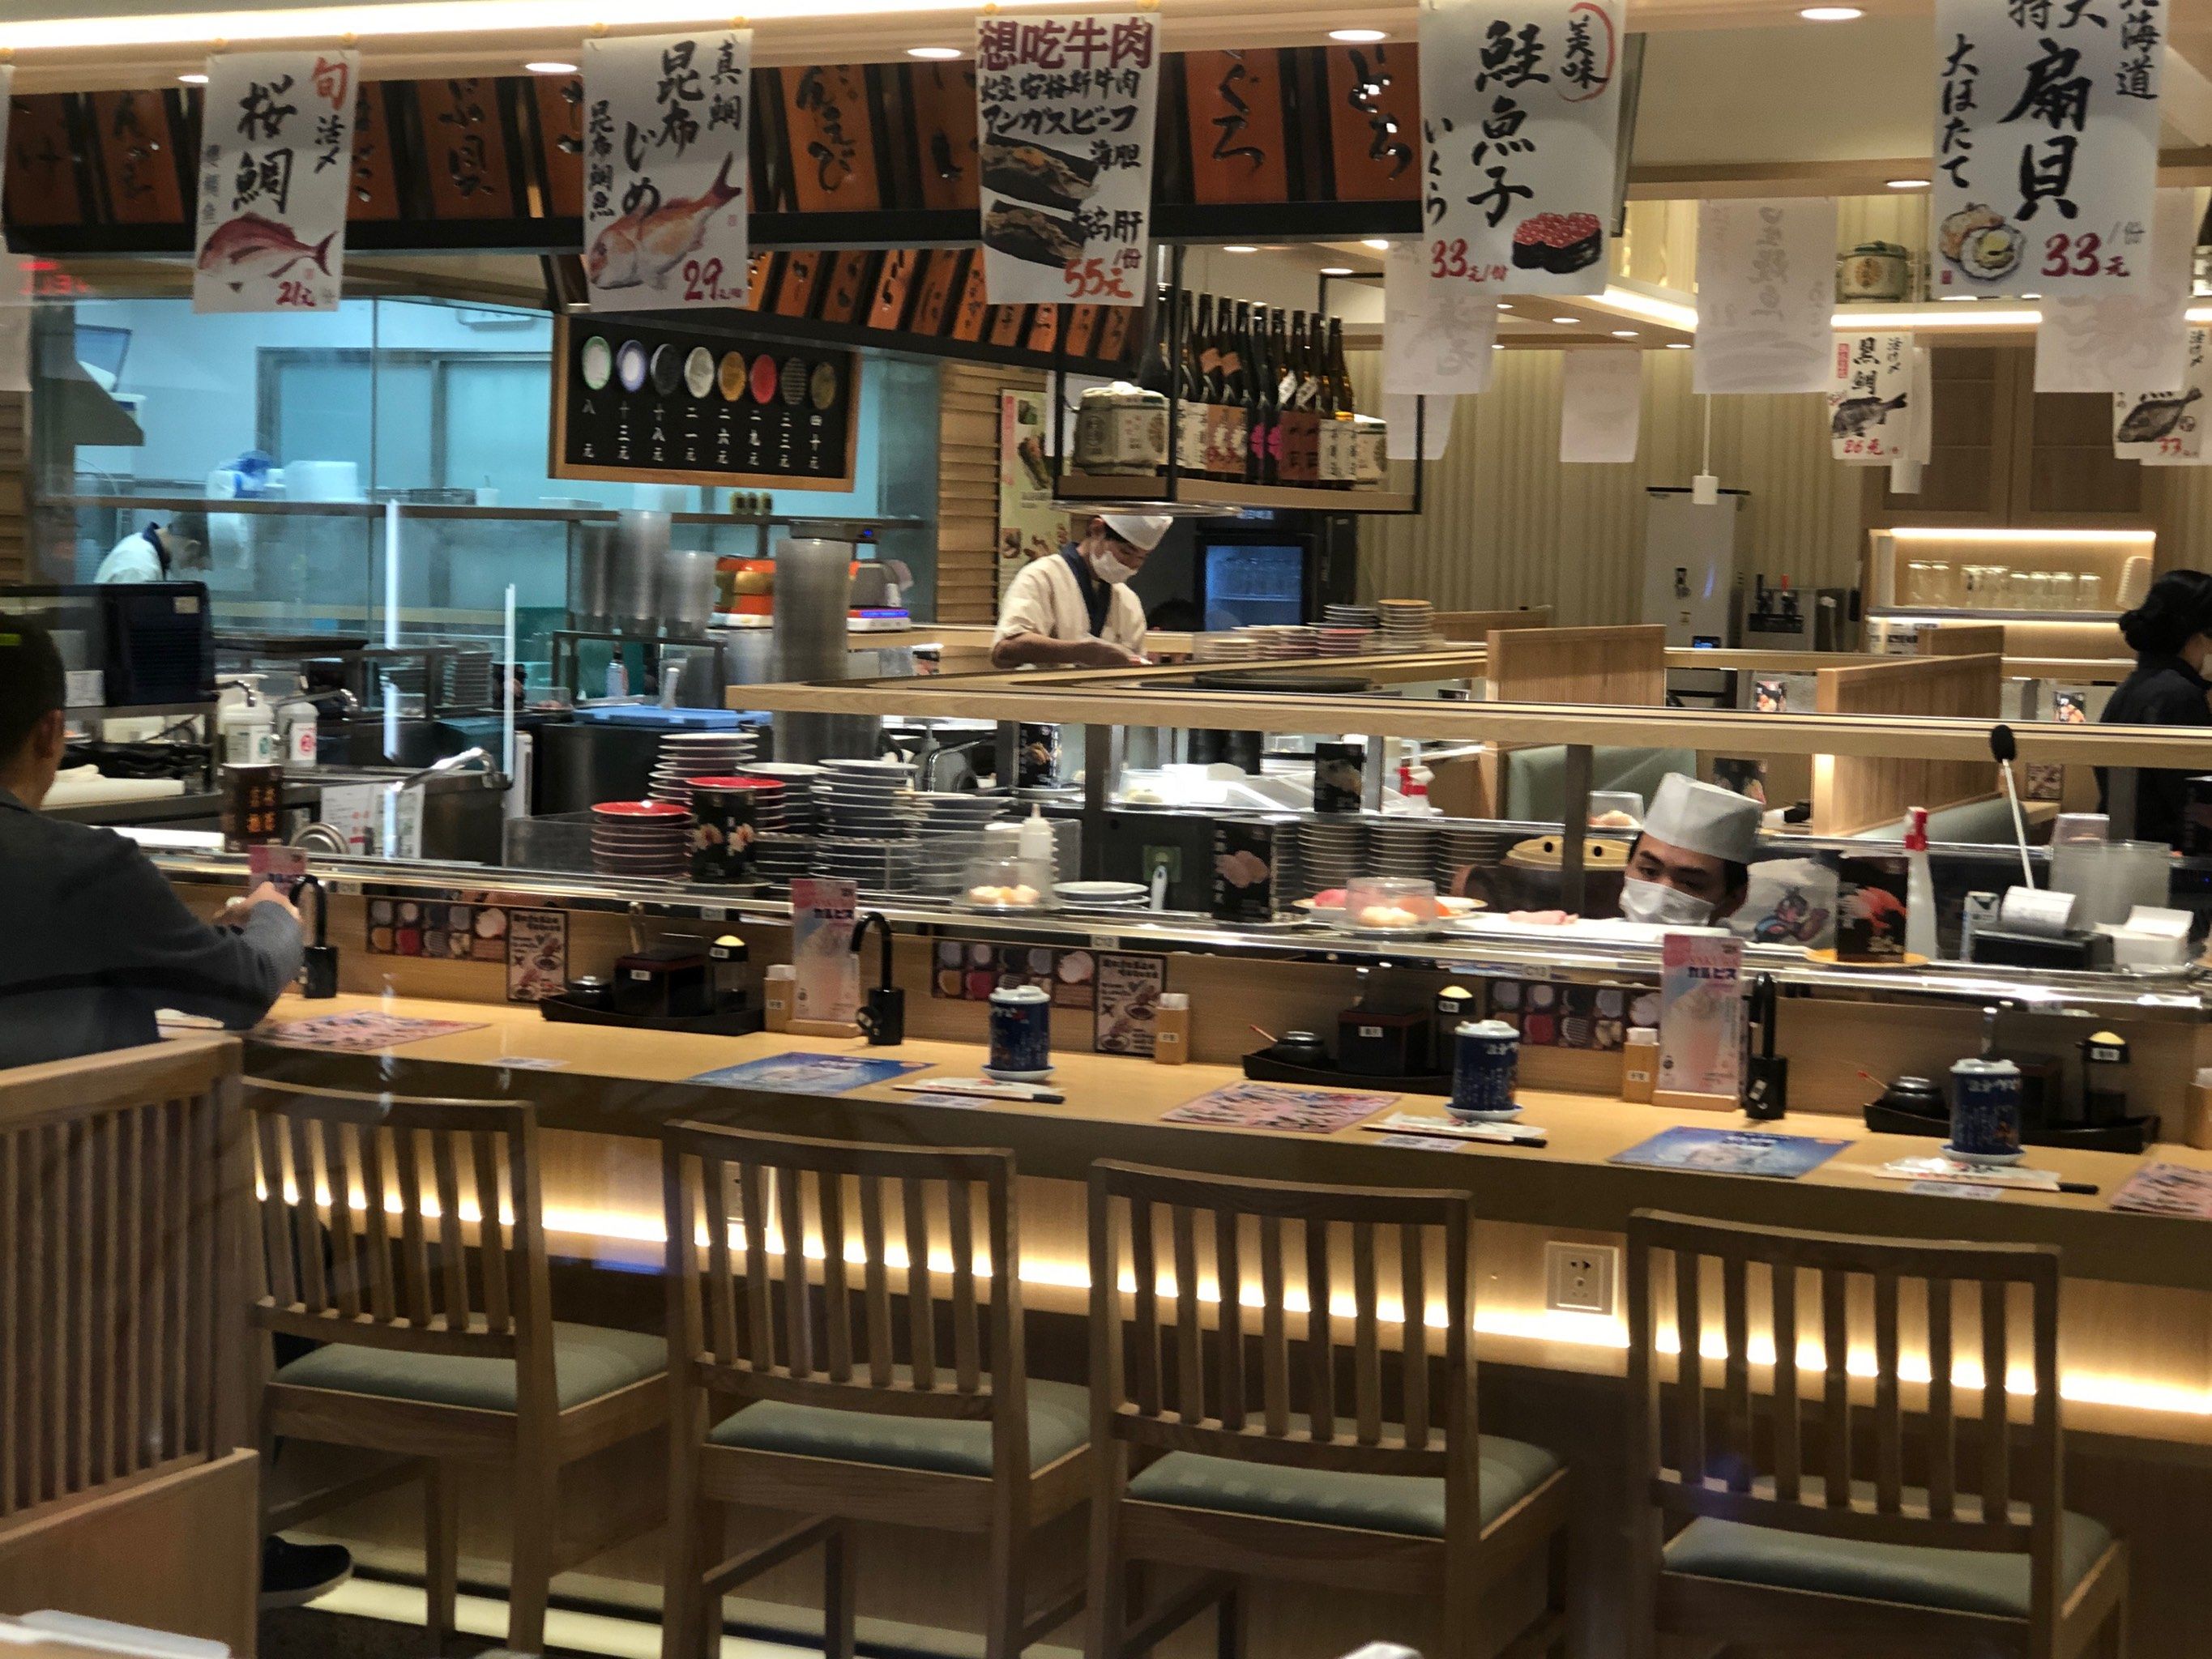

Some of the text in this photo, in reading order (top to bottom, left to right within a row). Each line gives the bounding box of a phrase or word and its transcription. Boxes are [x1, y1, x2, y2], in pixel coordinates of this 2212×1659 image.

[978, 17, 1154, 72] 想吃牛肉
[1561, 14, 1611, 90] 美味
[2116, 0, 2162, 100] 海道
[311, 57, 348, 111] 旬
[1939, 32, 1979, 189] 大ほたて
[981, 104, 1139, 135] アンガスビーフ
[1424, 117, 1454, 226] いくら
[1064, 258, 1134, 298] 55元
